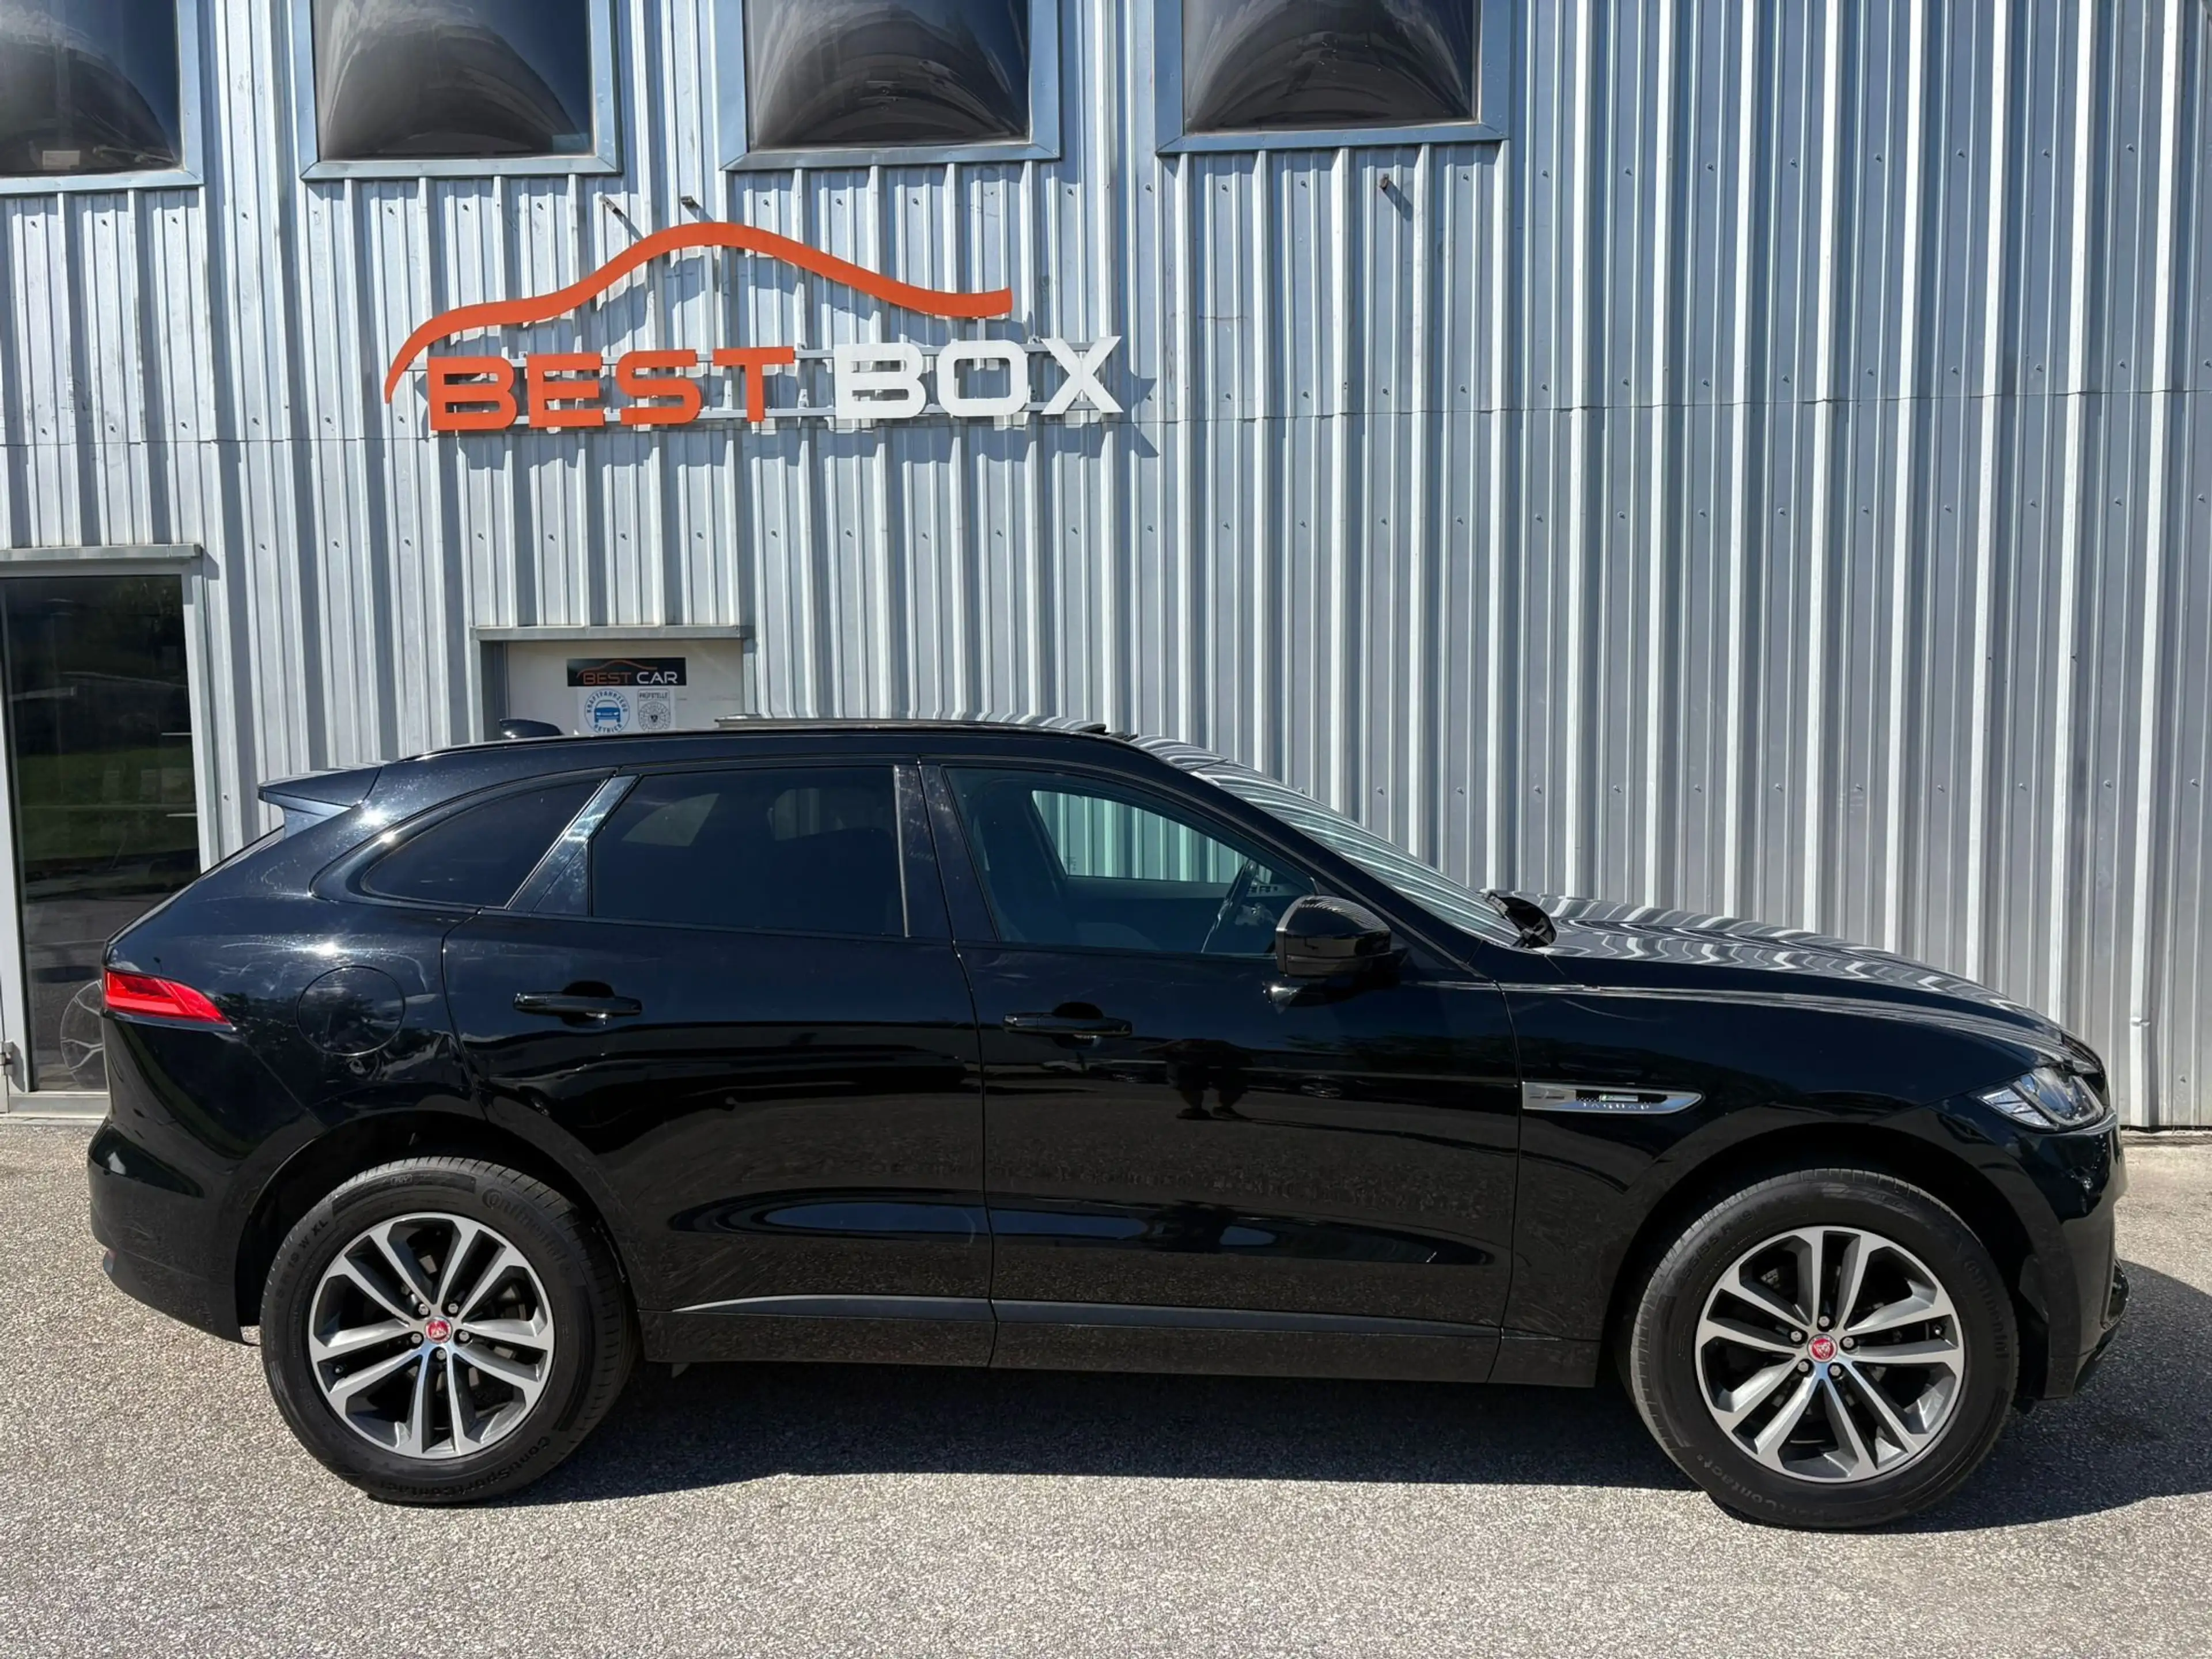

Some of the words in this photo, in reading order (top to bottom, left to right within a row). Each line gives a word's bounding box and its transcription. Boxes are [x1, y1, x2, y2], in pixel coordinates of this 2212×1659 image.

[428, 346, 794, 430] BEST
[835, 336, 1123, 419] BOX
[584, 672, 631, 685] BEST
[637, 672, 677, 684] CAR
[586, 691, 628, 714] KRAFTFAHRZEUG
